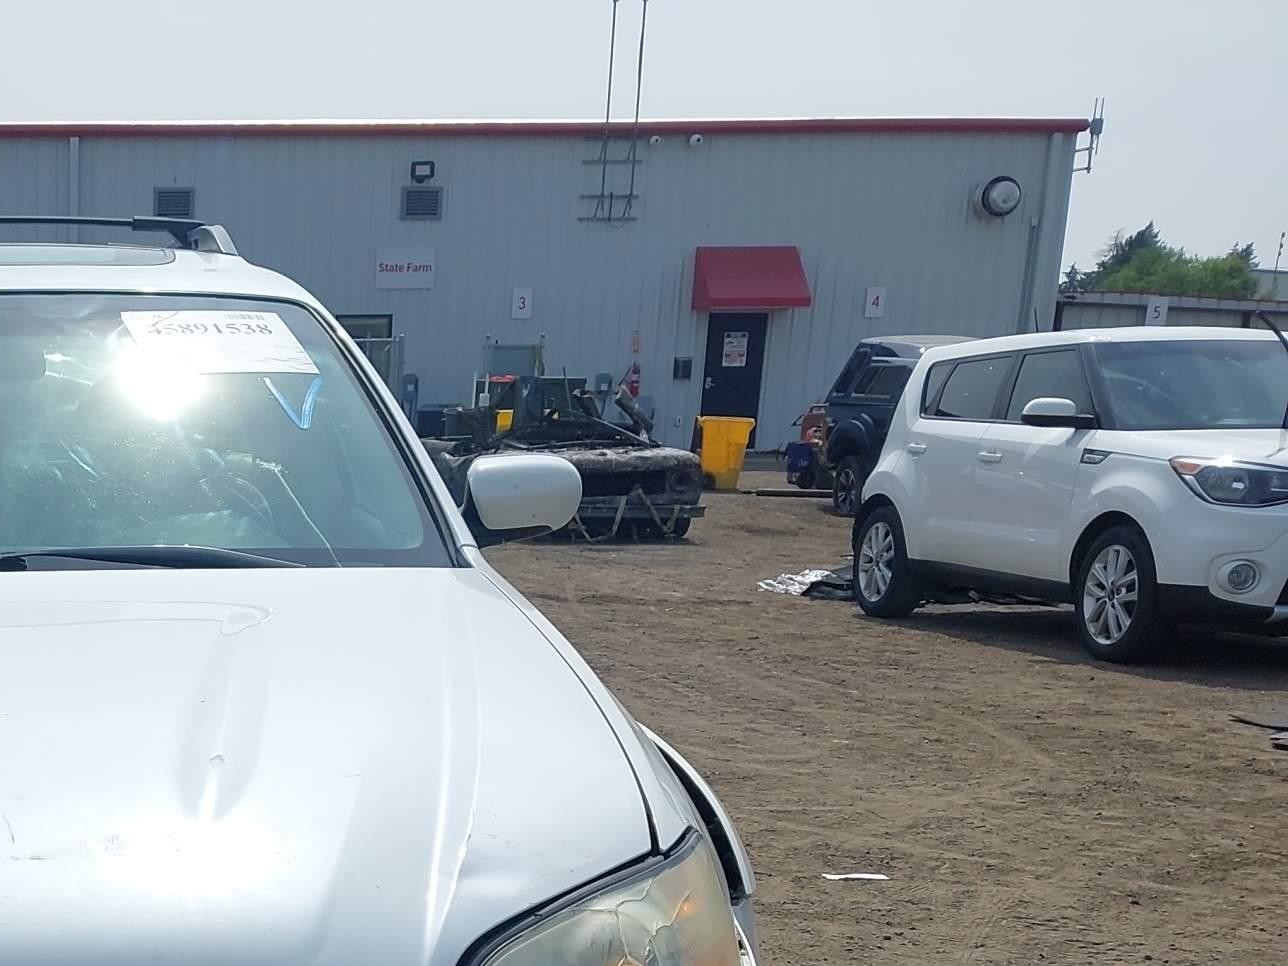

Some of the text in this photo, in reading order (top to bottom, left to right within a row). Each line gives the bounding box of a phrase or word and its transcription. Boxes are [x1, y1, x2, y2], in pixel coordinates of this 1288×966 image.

[378, 262, 432, 272] State Farm
[518, 296, 527, 310] 3
[871, 295, 880, 309] 4
[1152, 305, 1160, 319] 5
